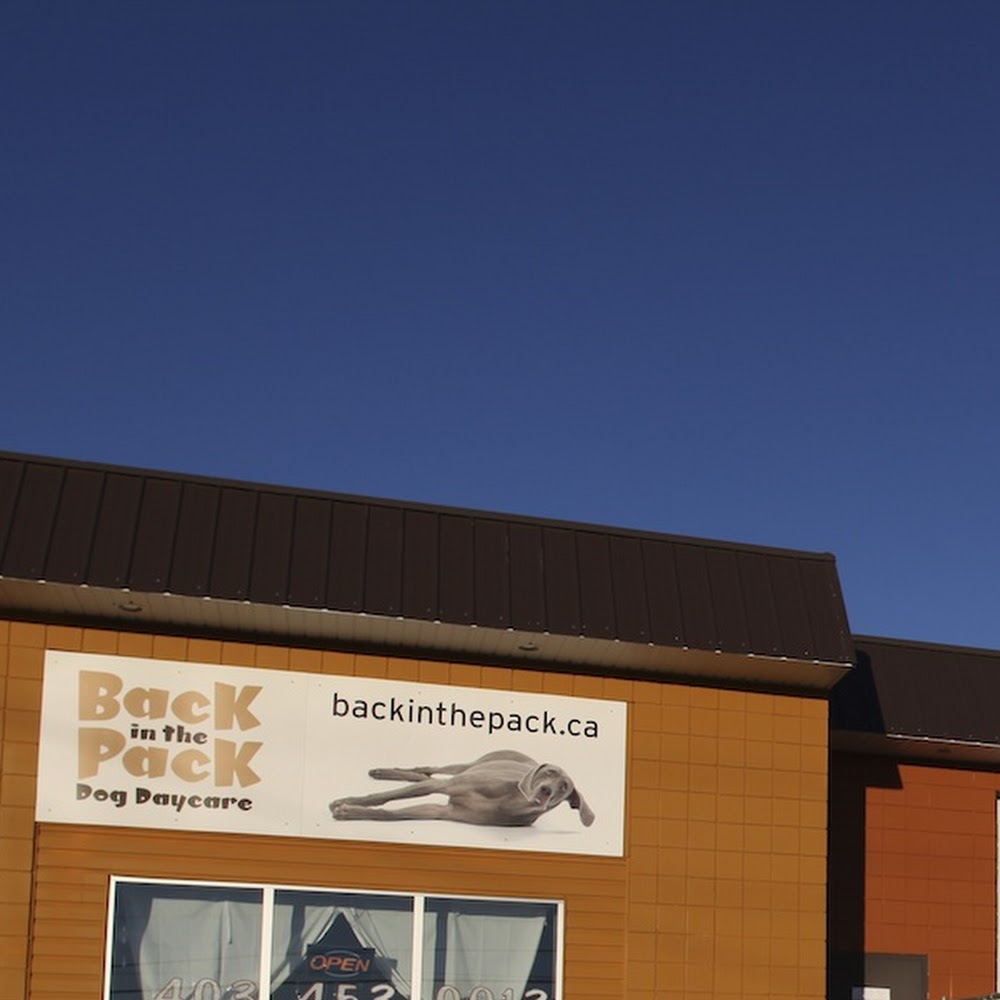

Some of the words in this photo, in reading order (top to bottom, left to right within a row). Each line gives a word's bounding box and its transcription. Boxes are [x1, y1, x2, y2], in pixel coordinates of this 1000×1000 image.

[332, 692, 599, 738] backinthepack.ca
[130, 723, 156, 741] in
[163, 725, 208, 745] the
[76, 783, 127, 808] Dog
[135, 787, 252, 812] Daycare
[309, 954, 371, 972] OPEN
